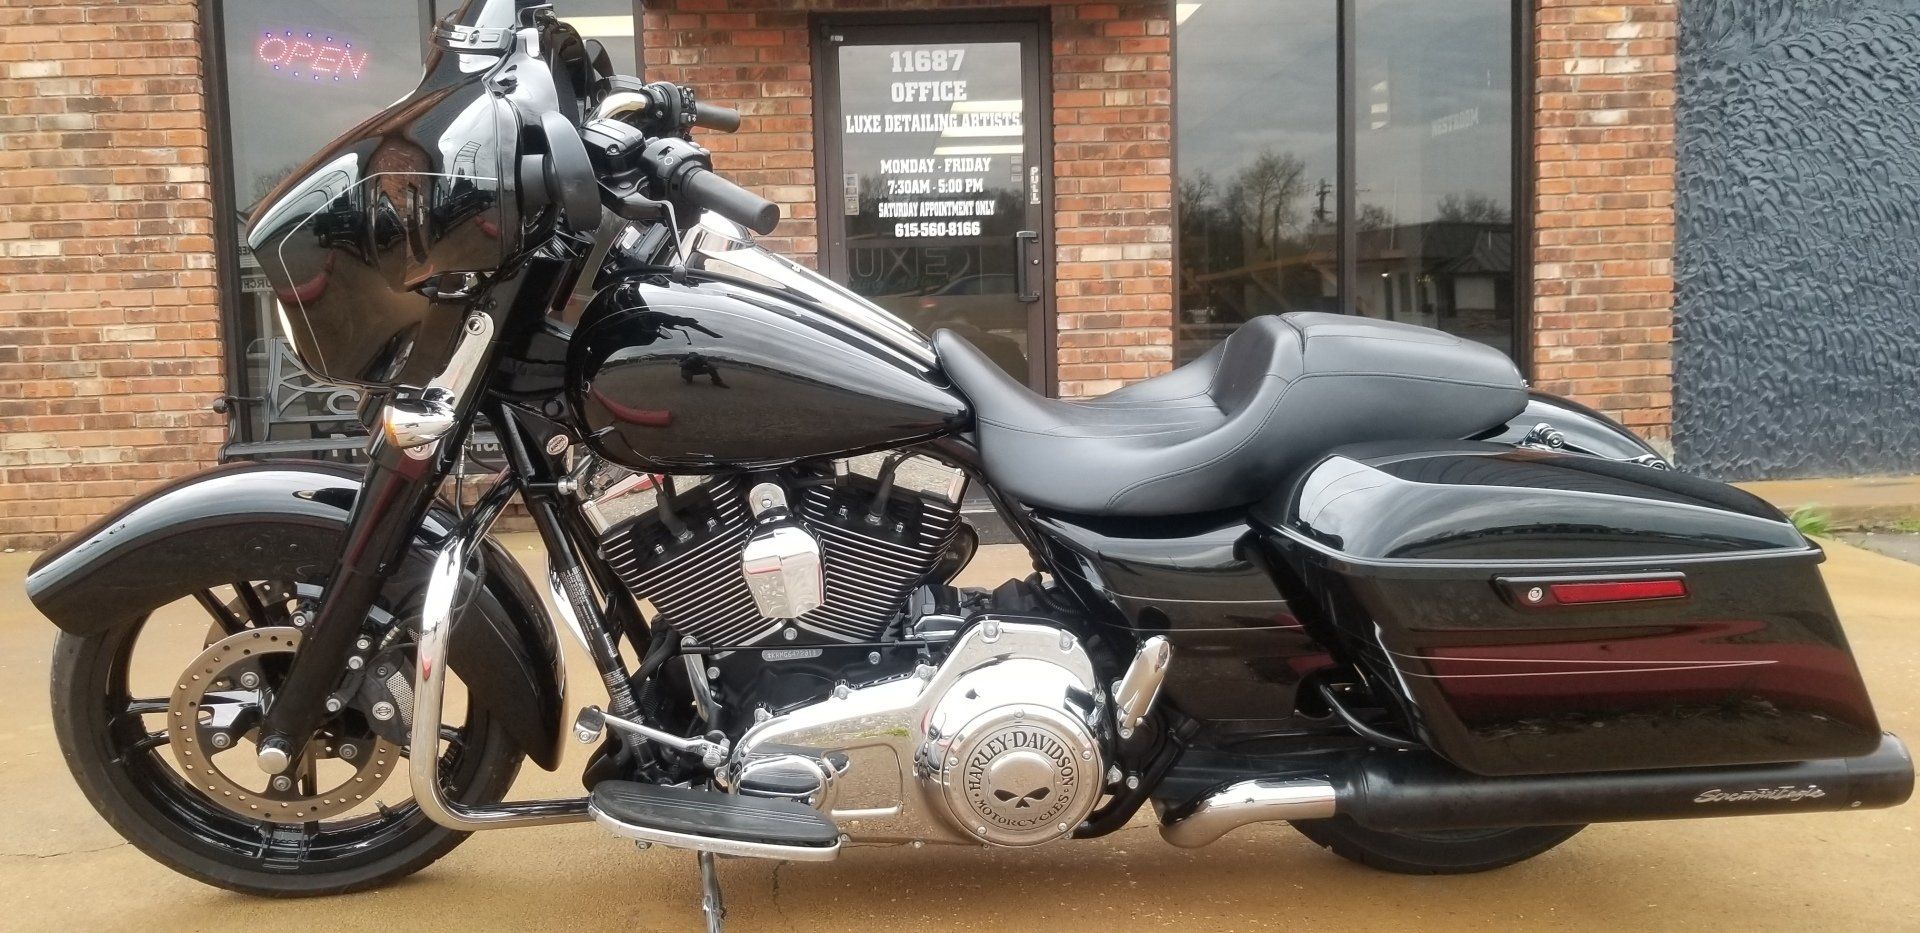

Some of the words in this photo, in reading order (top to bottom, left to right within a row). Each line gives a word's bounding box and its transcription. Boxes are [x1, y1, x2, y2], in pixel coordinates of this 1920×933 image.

[259, 37, 368, 76] OPEN
[890, 50, 965, 72] 11687
[891, 81, 967, 102] OFFICE
[846, 115, 881, 133] LUXE
[885, 113, 957, 132] DETAILING
[960, 112, 1020, 129] ARTISTS
[880, 158, 935, 174] MONDAY
[944, 157, 992, 172] FRIDAY
[887, 180, 930, 194] 7:30AM
[938, 179, 963, 193] 5:00
[965, 178, 983, 192] PM
[1030, 166, 1040, 204] PULL
[878, 202, 918, 218] SATURDAY
[919, 201, 974, 217] APPOINTMENT
[975, 200, 995, 215] ONLY
[894, 222, 981, 237] 615-560-8166
[847, 248, 950, 283] UXE
[968, 730, 1074, 792] HARLEY-DAVIDSON
[974, 794, 1069, 827] MOTORCYCLES
